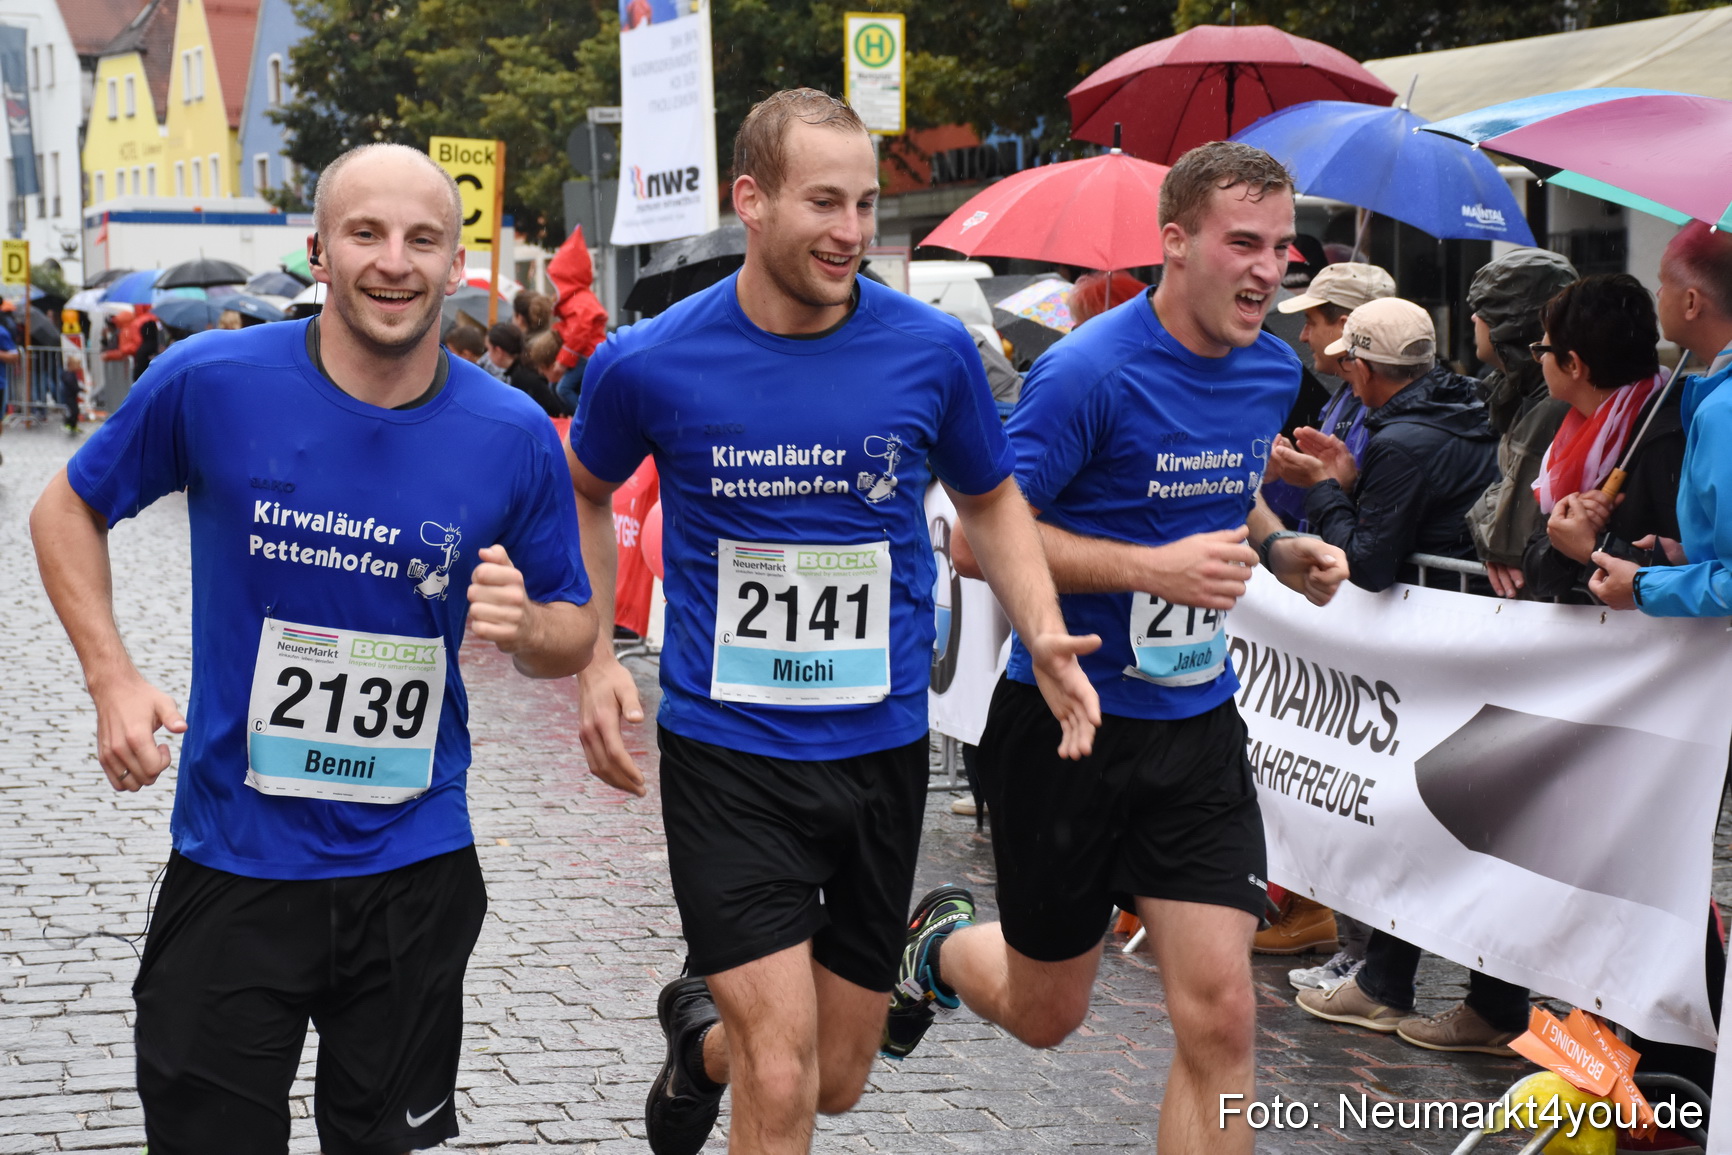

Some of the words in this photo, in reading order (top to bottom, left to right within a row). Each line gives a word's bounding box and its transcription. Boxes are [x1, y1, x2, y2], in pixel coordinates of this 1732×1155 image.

[439, 143, 496, 166] Block
[454, 173, 483, 227] C
[8, 253, 22, 274] D
[712, 443, 847, 468] Kirwaläufer
[1155, 448, 1244, 473] Kirwaläufer
[251, 477, 296, 494] JAKO
[711, 475, 849, 498] Pettenhofen
[1147, 476, 1245, 499] Pettenhofen
[254, 499, 401, 545] Kirwaläufer
[250, 534, 399, 579] Pettenhofen
[732, 559, 787, 573] NeuerMarkt
[797, 551, 877, 570] BOCK
[736, 581, 869, 642] 2141
[277, 641, 339, 659] NeuerMarkt
[351, 638, 438, 665] BOCK
[1173, 647, 1213, 672] Jakob
[349, 659, 376, 668] inspired
[378, 662, 386, 670] by
[409, 664, 437, 672] concepts
[773, 658, 834, 682] Michi
[269, 666, 430, 739] 2139
[1226, 634, 1401, 757] DYNAMICS.
[255, 720, 263, 732] C
[304, 749, 377, 779] Benni
[1247, 737, 1376, 827] AHRFREUDE.
[1550, 1026, 1606, 1081] BRANDING
